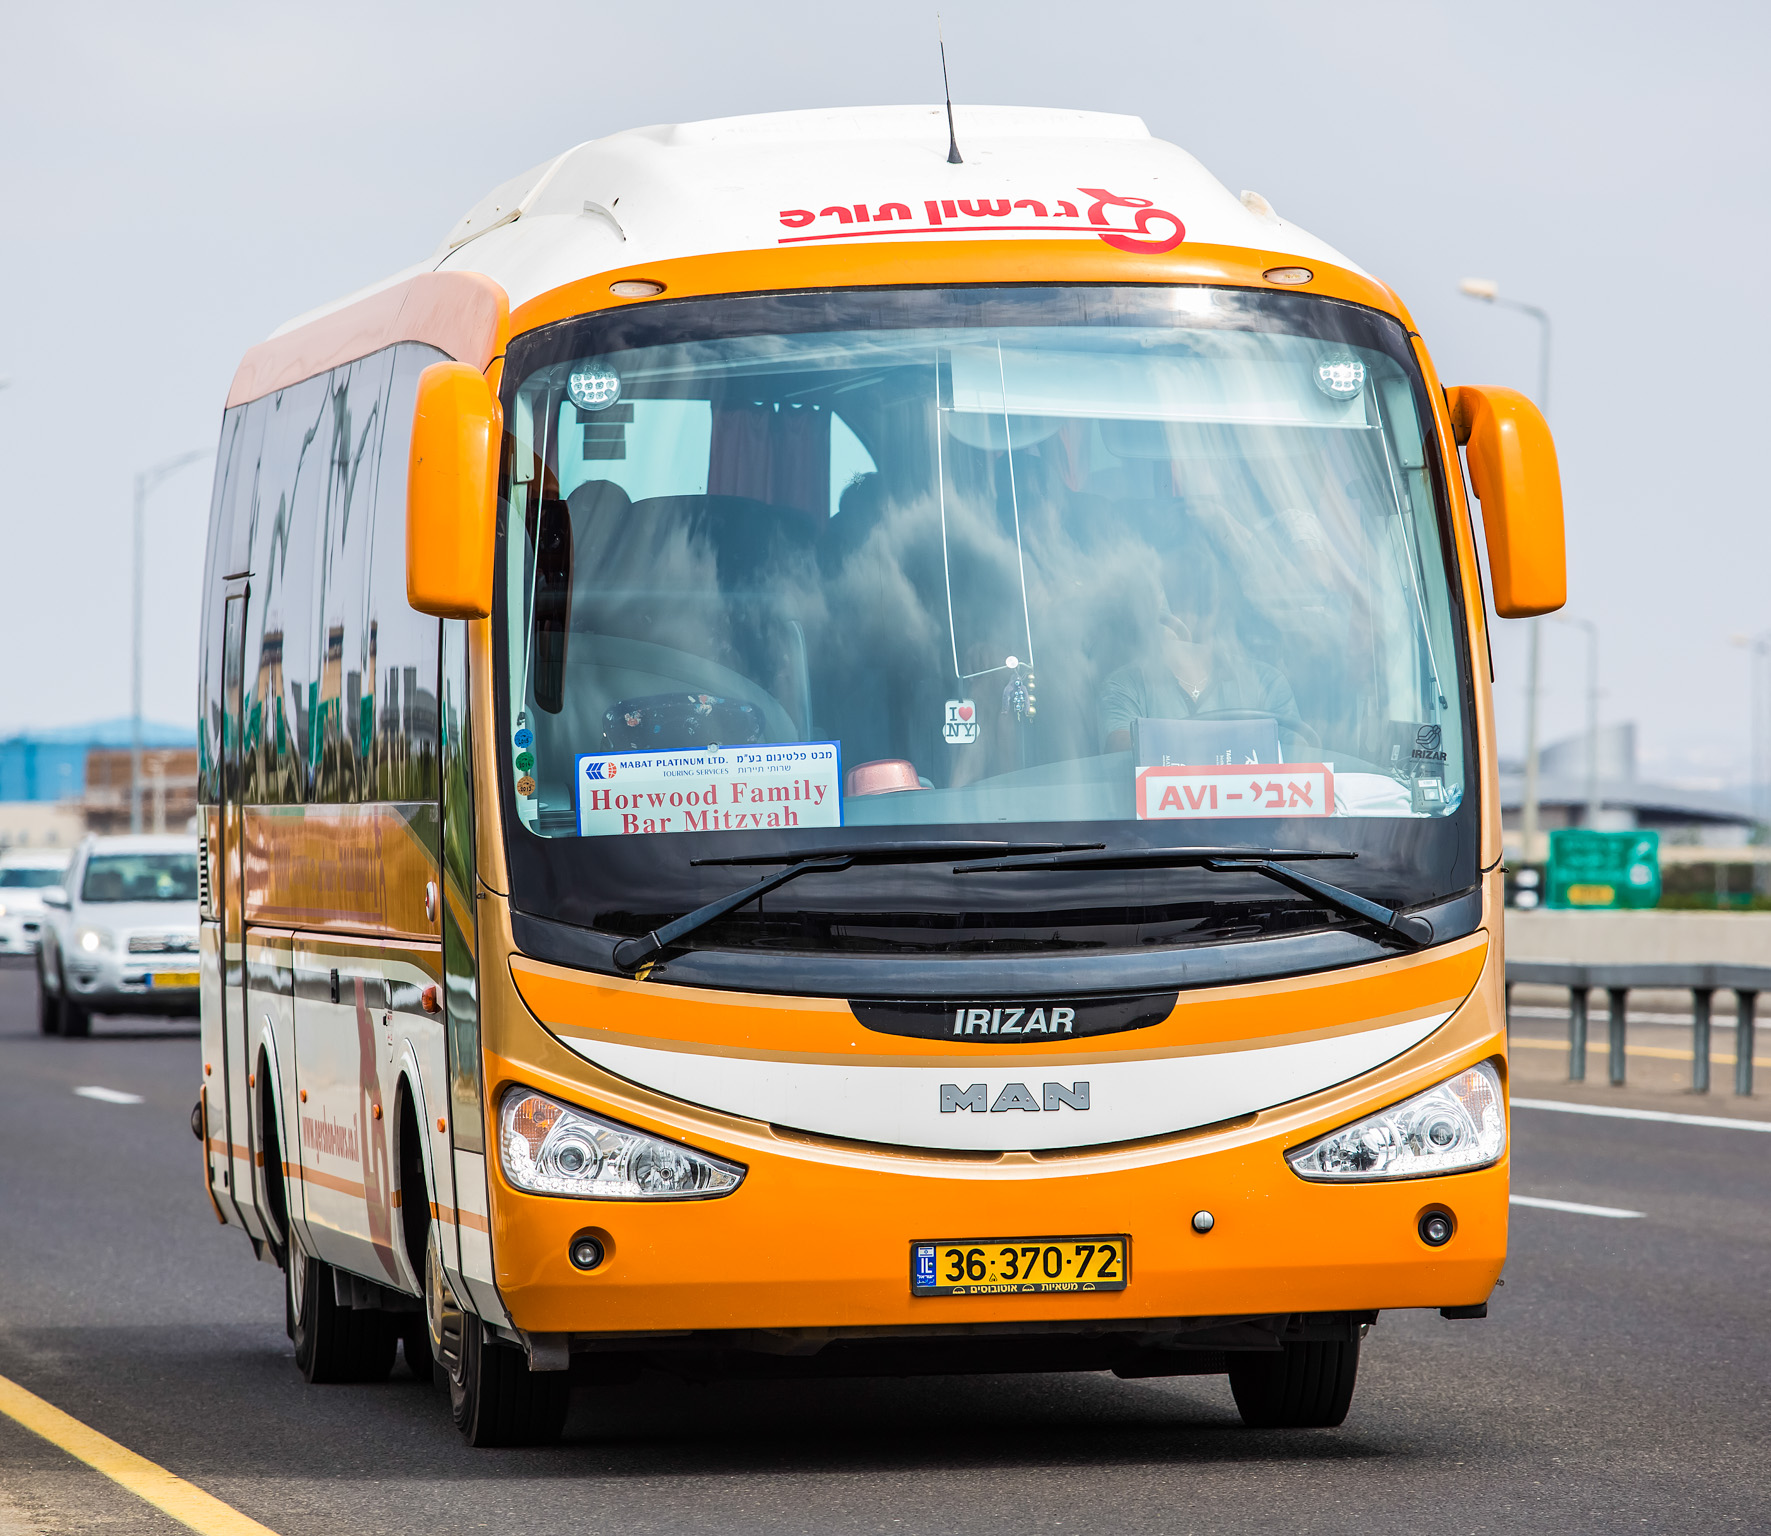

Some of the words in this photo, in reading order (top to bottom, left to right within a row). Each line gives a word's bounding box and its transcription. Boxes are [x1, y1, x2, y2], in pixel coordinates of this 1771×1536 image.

[946, 722, 976, 737] NY
[766, 752, 807, 762] פלטינום
[811, 751, 833, 760] מבט
[1411, 749, 1447, 761] IRIZAR
[619, 760, 653, 769] MABAT
[656, 757, 704, 767] PLATINUM
[708, 756, 729, 765] LTD.
[767, 764, 791, 772] שרותי
[663, 769, 695, 777] TOURING
[696, 768, 729, 776] SERVICES
[590, 784, 719, 811] Horwood
[730, 779, 828, 805] Family
[1158, 785, 1218, 811] AVI
[1249, 781, 1314, 808] אבי
[621, 813, 672, 835] Bar
[683, 805, 800, 833] Mitzvah
[953, 1007, 1076, 1036] IRIZAR
[940, 1081, 1090, 1113] MAN
[921, 1257, 933, 1273] IL
[970, 1284, 1018, 1294] אוטובוסים
[1041, 1282, 1079, 1292] משאיות
